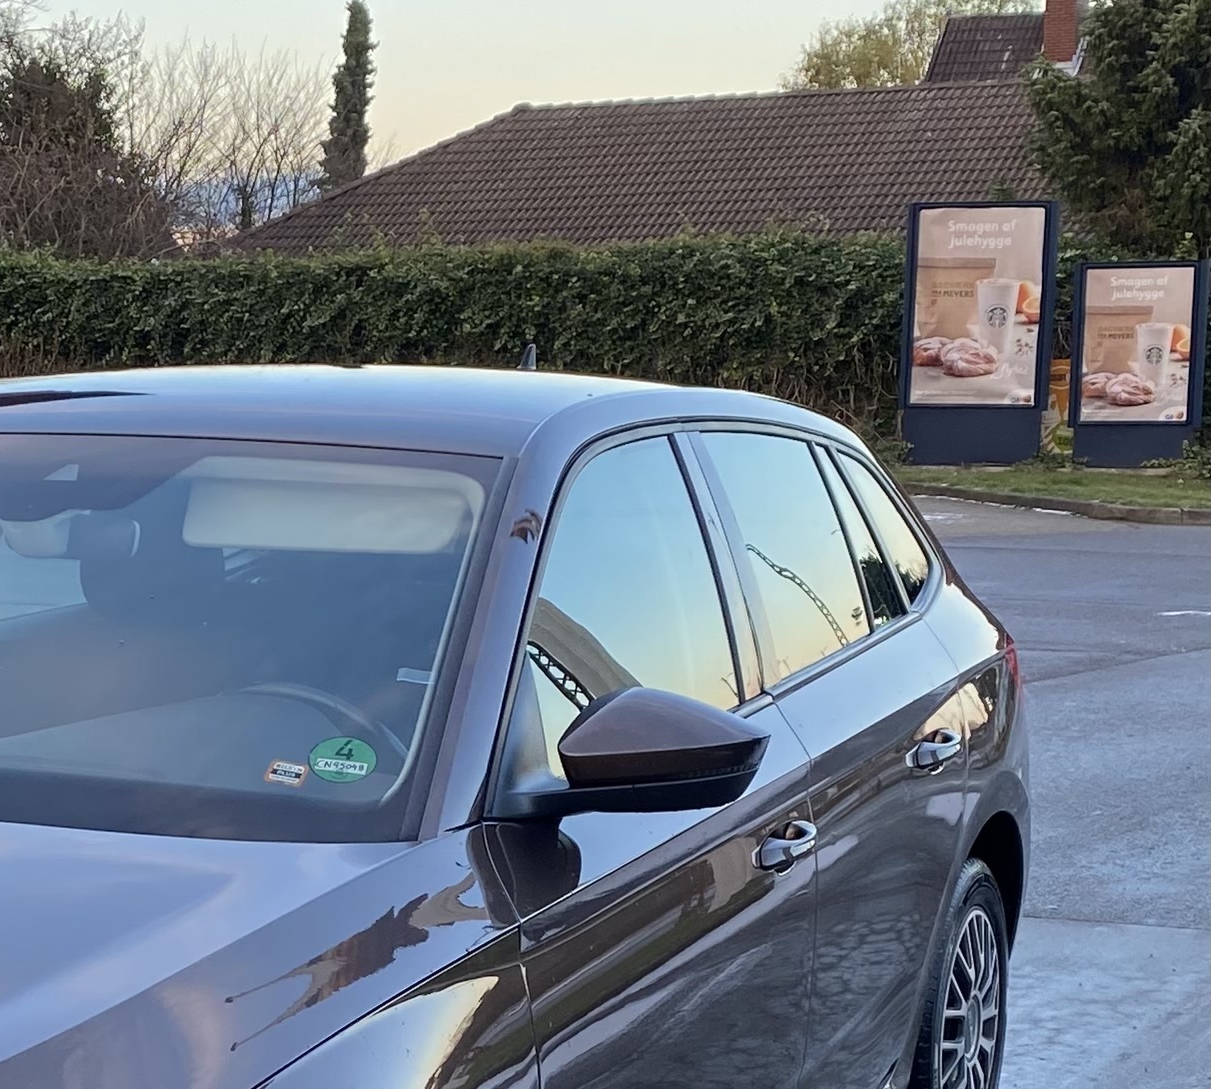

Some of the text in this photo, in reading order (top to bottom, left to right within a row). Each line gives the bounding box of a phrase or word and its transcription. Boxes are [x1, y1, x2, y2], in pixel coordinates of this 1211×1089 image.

[948, 219, 1017, 235] Smagen af
[948, 235, 1012, 249] julehygge
[1111, 276, 1154, 289] Smagen
[1111, 288, 1165, 301] julehygge
[335, 739, 354, 760] 4
